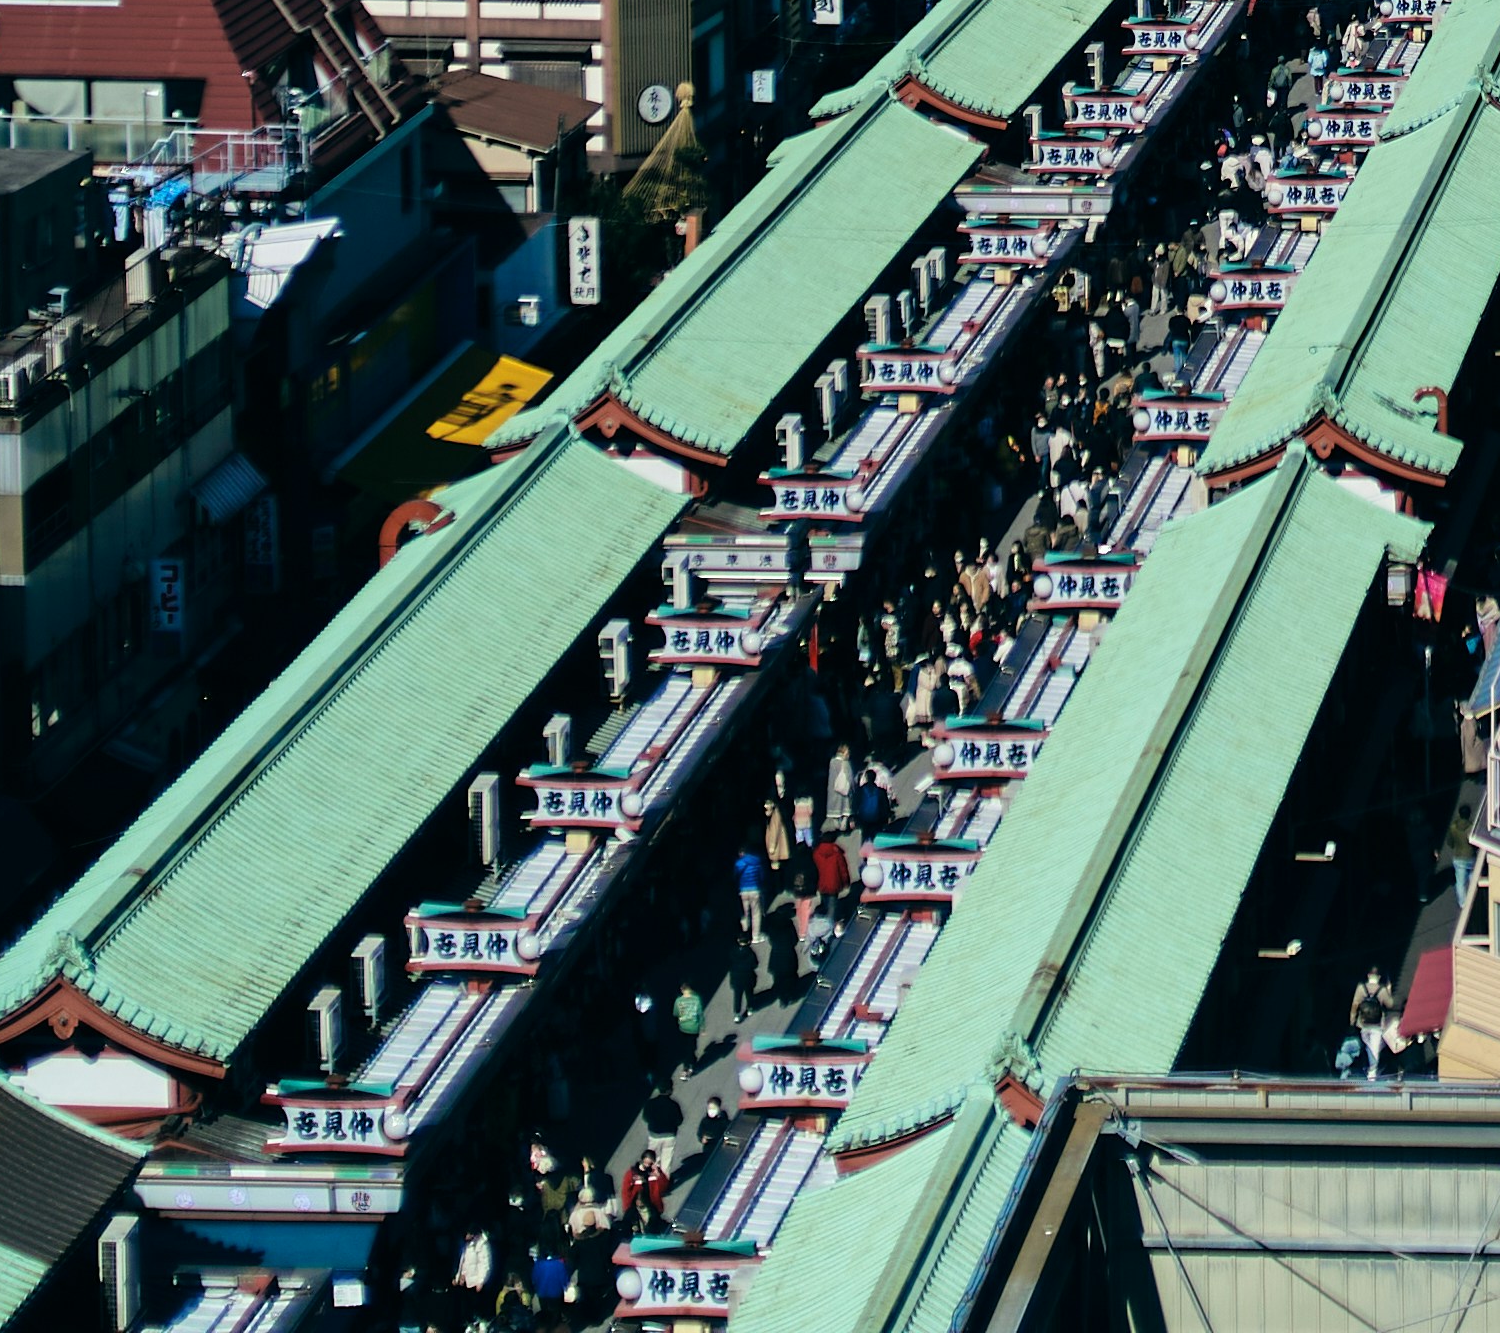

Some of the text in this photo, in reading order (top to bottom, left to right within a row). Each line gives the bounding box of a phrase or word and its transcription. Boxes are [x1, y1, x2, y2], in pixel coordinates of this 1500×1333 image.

[574, 287, 595, 299] 秋月
[160, 565, 180, 624] コーヒー
